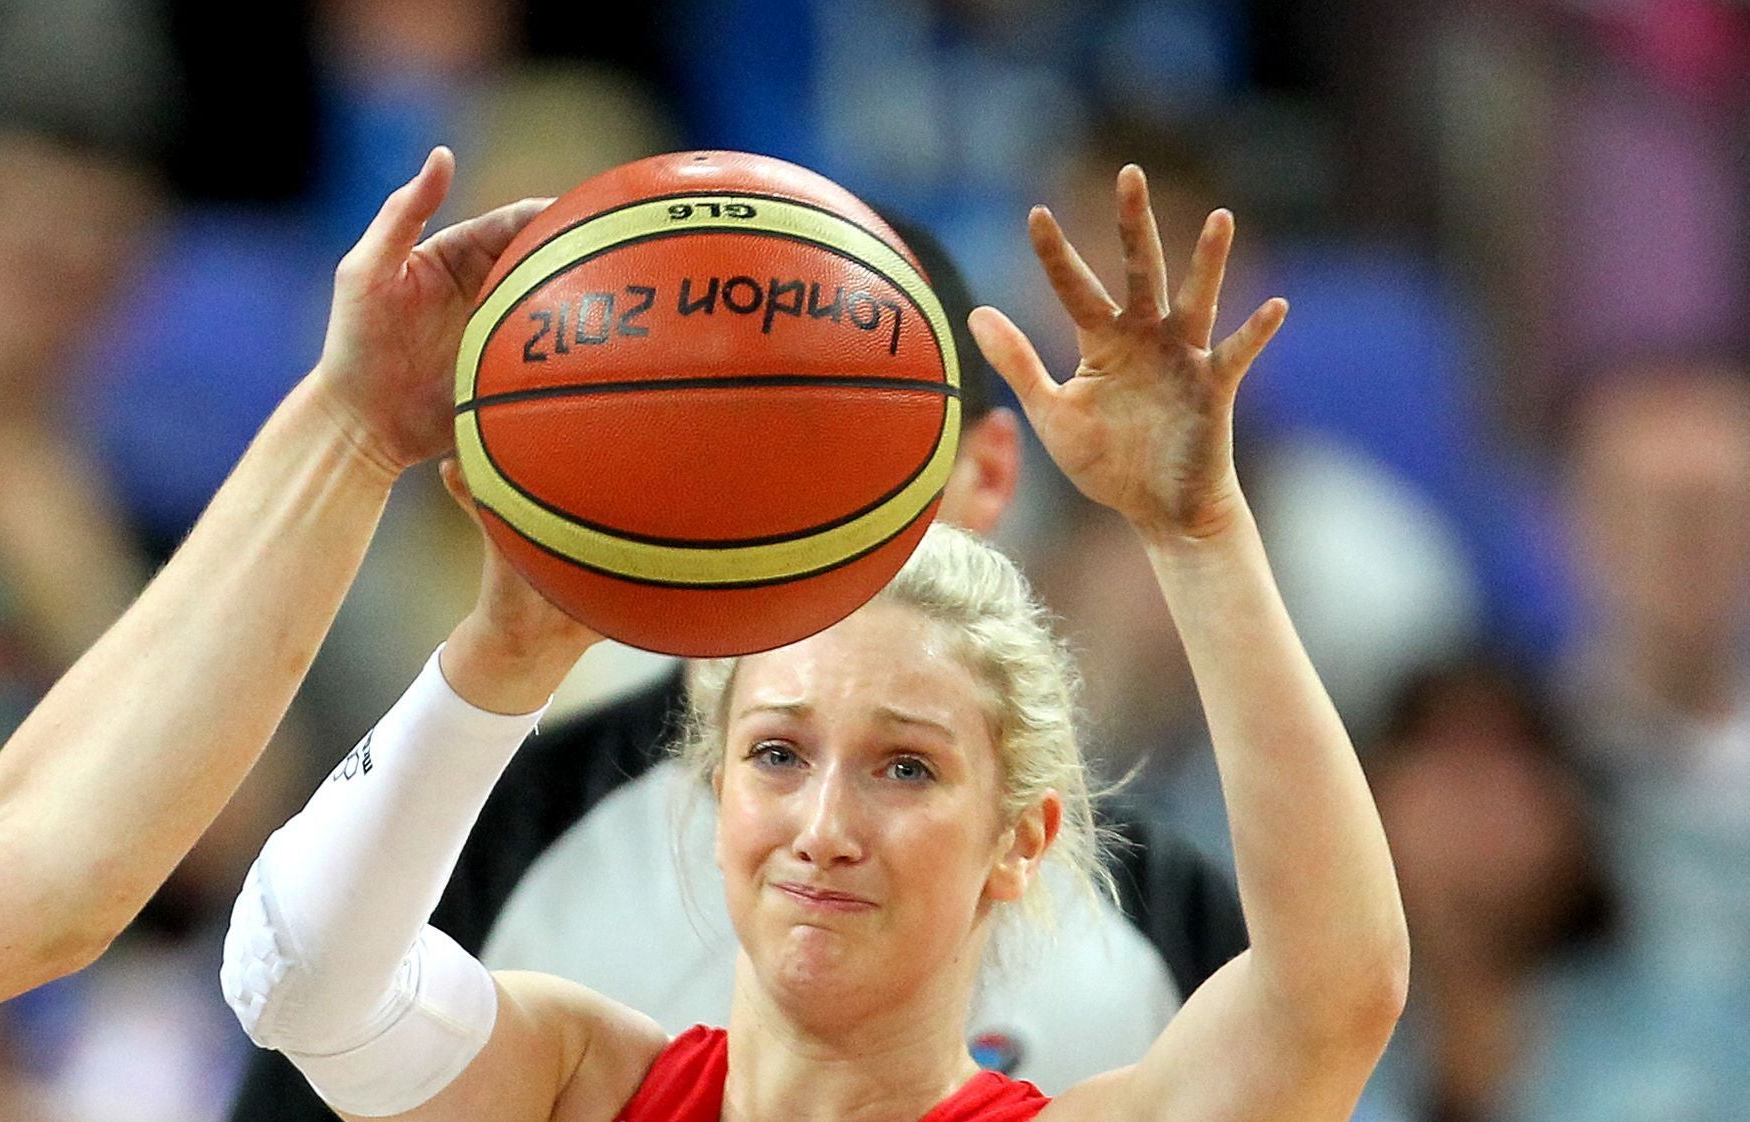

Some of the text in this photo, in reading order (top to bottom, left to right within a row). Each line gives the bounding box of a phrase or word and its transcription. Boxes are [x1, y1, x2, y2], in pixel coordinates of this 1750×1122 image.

[668, 203, 757, 219] GL6
[522, 275, 902, 362] London 2012
